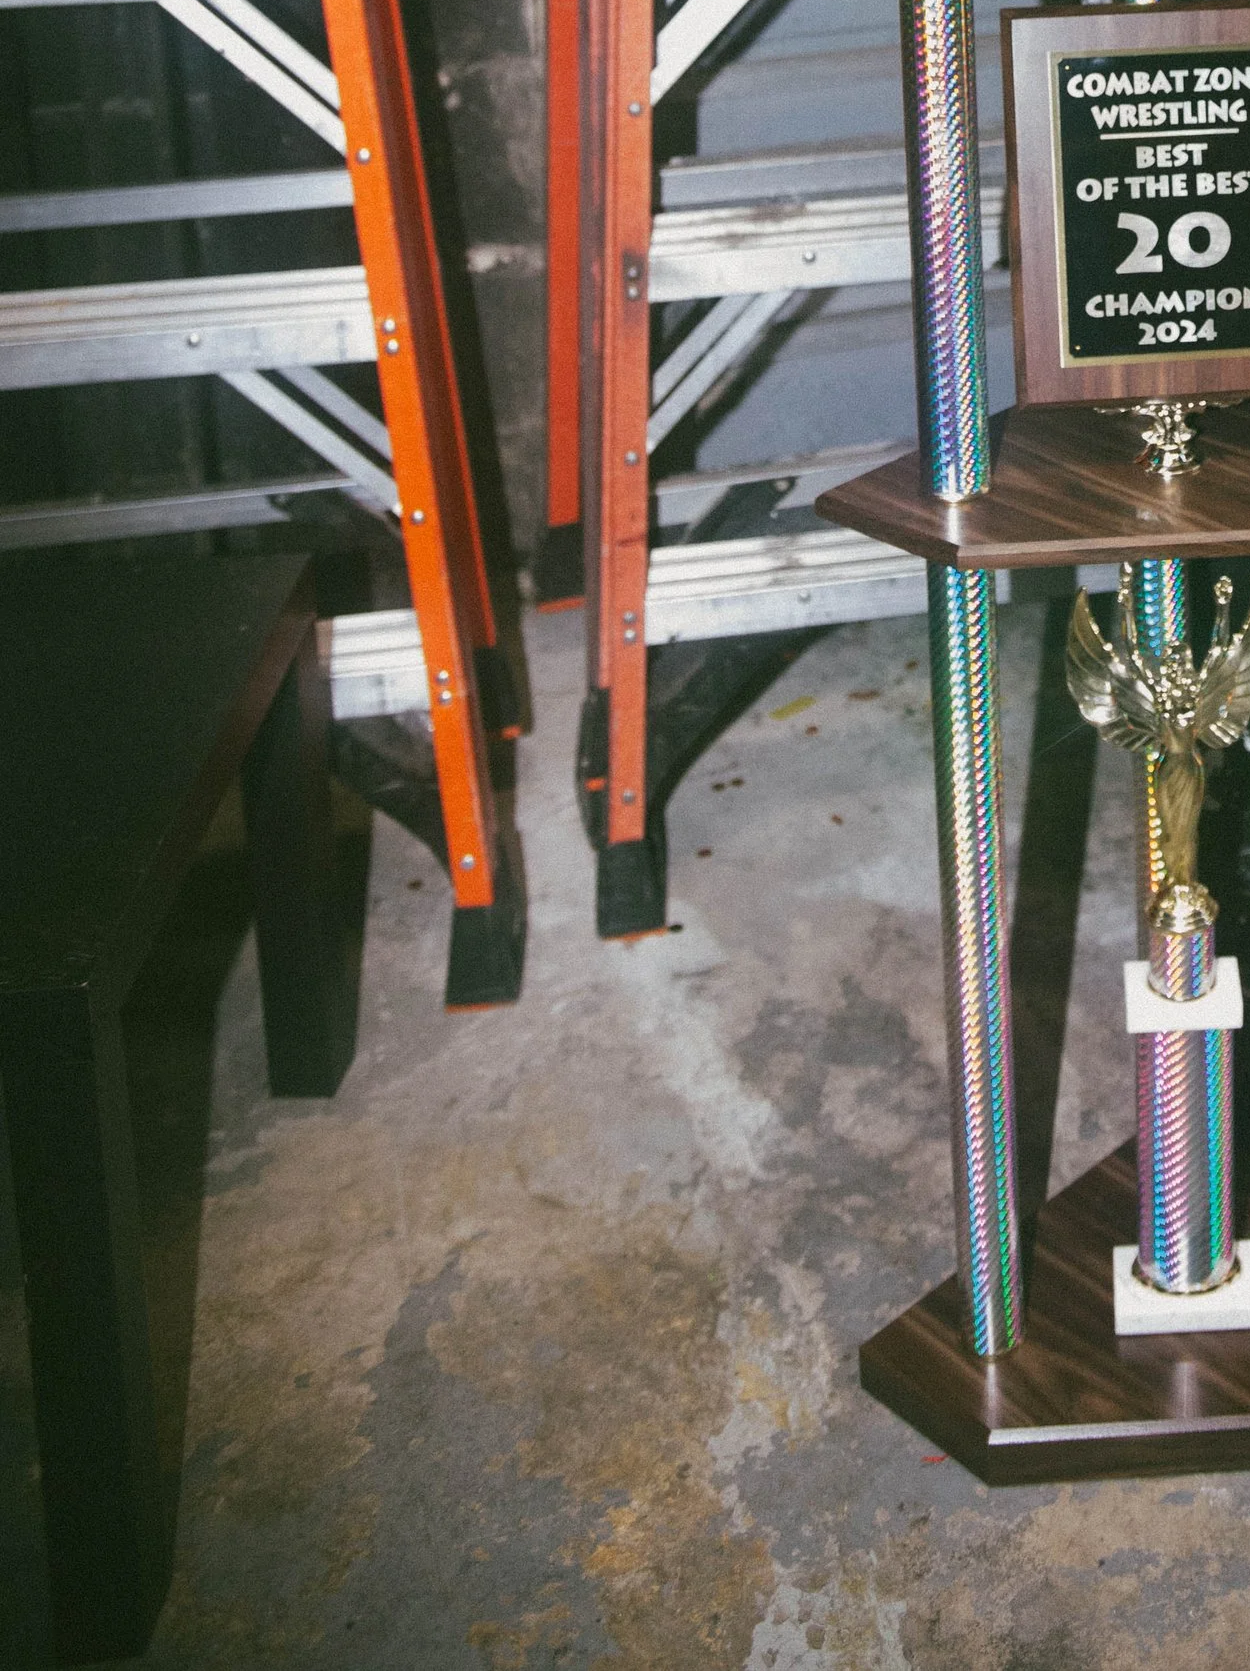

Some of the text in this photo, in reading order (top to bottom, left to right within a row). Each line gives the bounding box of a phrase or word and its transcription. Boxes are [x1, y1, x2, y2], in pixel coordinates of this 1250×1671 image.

[1066, 69, 1190, 98] COMBAT
[1090, 98, 1248, 129] WRESTLING
[1136, 143, 1208, 169] BEST
[1076, 177, 1118, 202] OF
[1124, 174, 1188, 200] THE
[1115, 211, 1232, 274] 20
[1138, 319, 1218, 346] 2024
